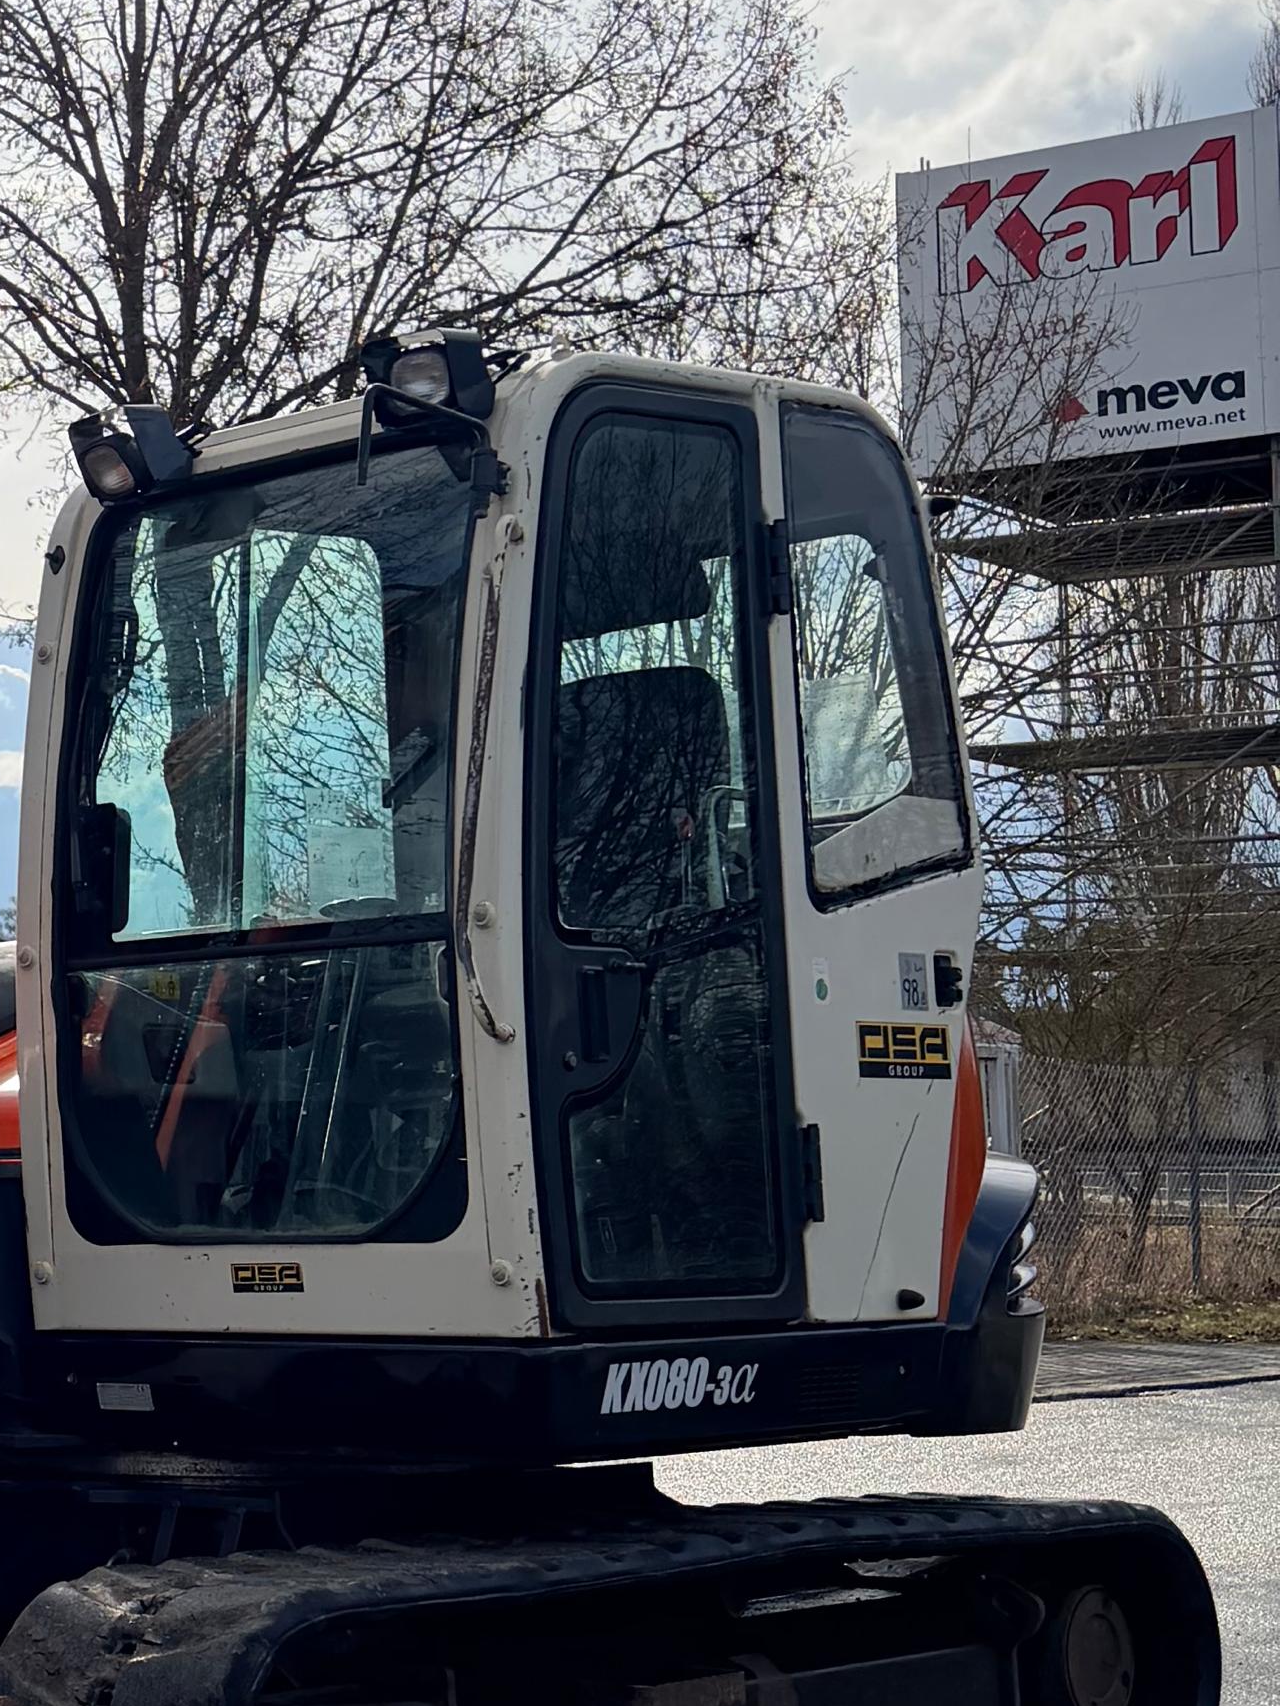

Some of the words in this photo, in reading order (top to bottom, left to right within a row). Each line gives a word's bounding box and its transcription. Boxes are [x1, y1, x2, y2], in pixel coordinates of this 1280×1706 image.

[937, 135, 1239, 296] Karl
[1096, 370, 1246, 417] meva
[1098, 408, 1247, 439] www.meva.net
[888, 1064, 924, 1076] GROUP
